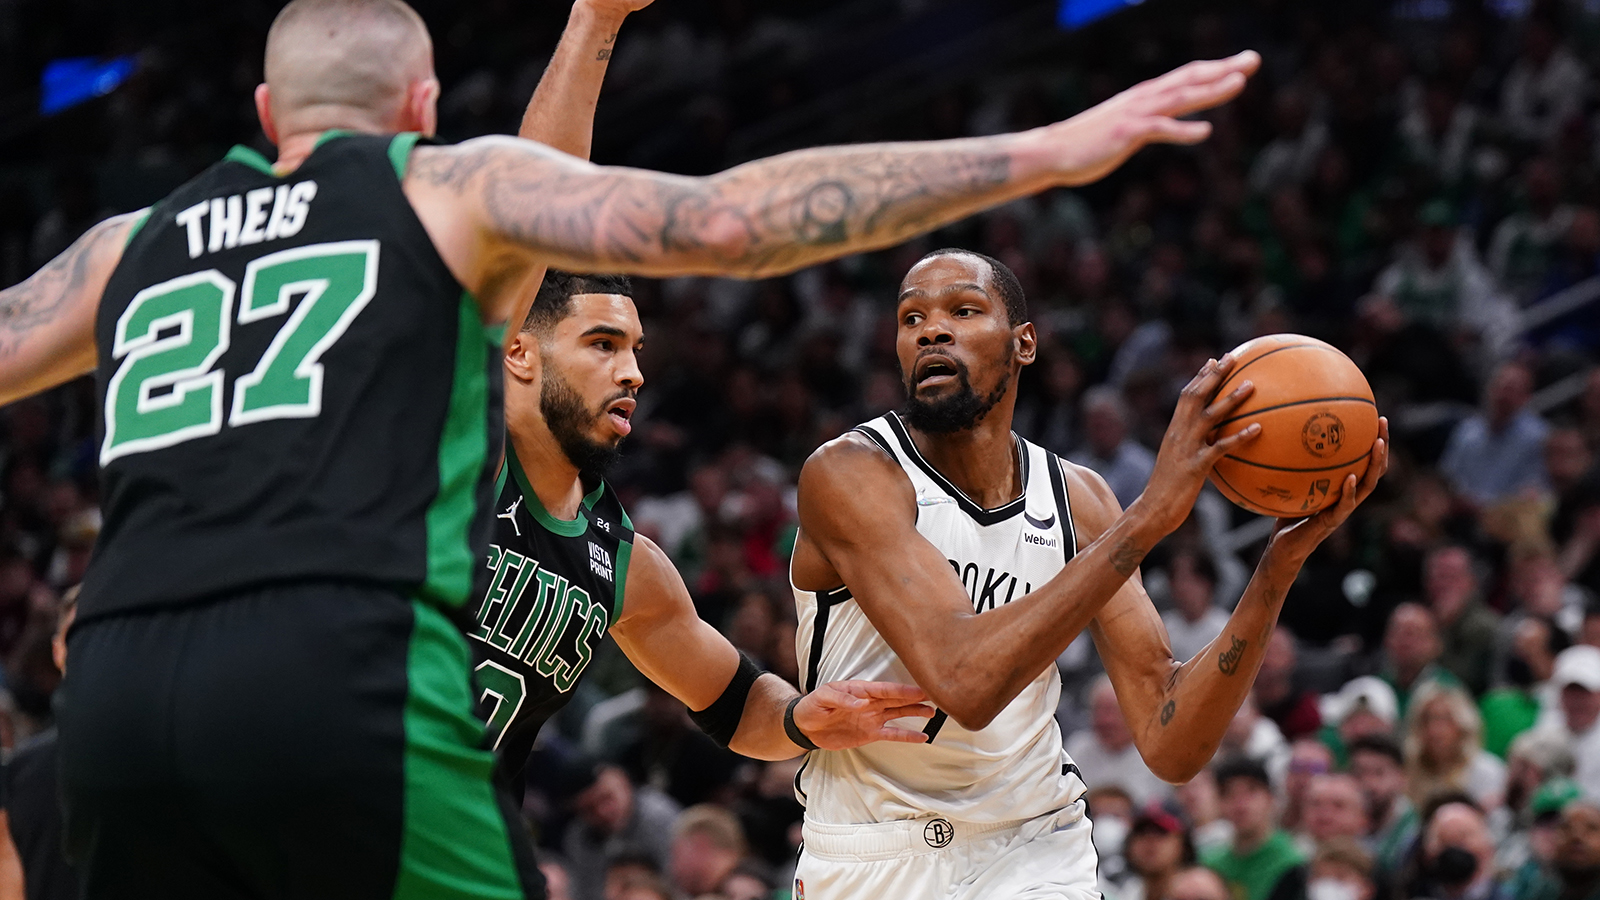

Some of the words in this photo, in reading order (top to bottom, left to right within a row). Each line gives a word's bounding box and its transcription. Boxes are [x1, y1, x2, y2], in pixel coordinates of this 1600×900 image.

[175, 180, 318, 259] THEIS
[99, 239, 381, 468] 27
[596, 517, 611, 533] 24
[1024, 532, 1057, 549] Webull
[587, 541, 613, 569] VISTA
[589, 558, 613, 582] PRINT
